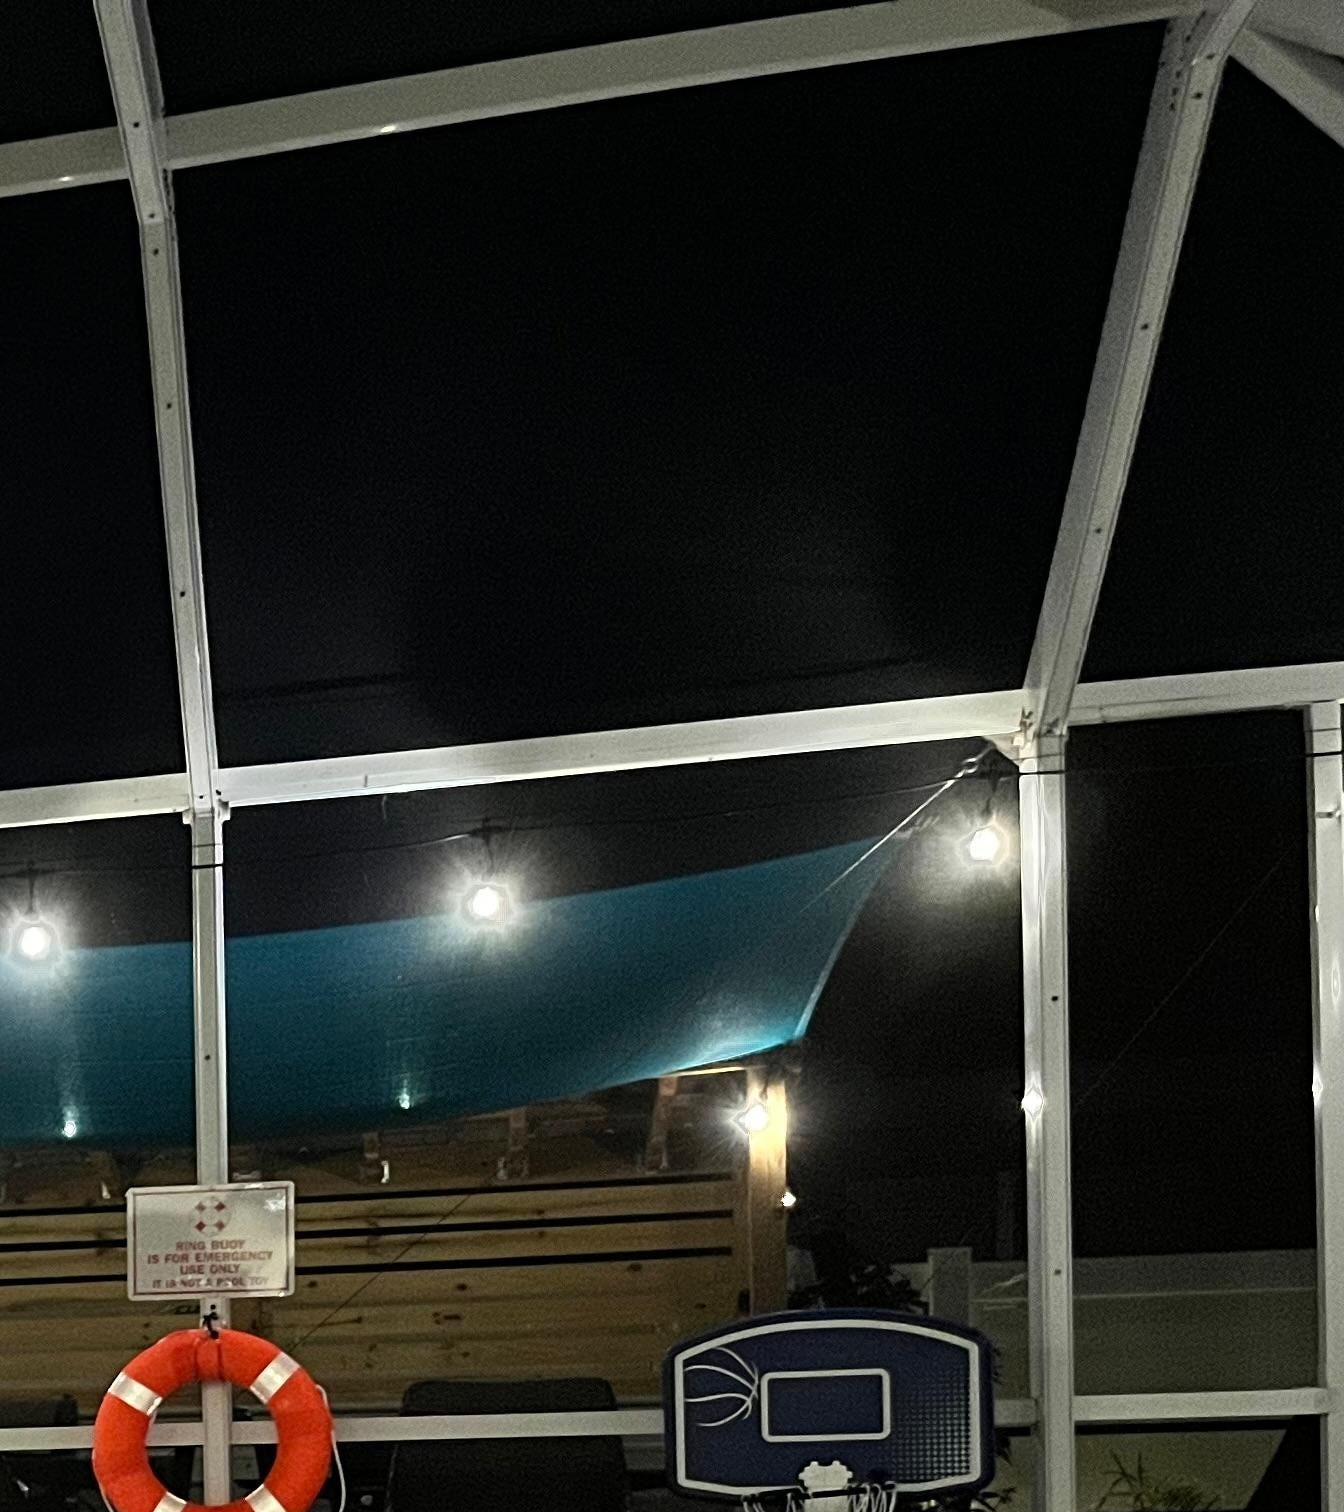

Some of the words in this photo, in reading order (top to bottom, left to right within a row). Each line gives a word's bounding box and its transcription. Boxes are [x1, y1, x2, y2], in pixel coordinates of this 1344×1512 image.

[175, 1241, 206, 1251] RING
[210, 1239, 246, 1250] BUOY
[147, 1254, 160, 1264] IS
[164, 1253, 189, 1264] FOR
[194, 1250, 274, 1263] EMERGENCY
[179, 1265, 205, 1275] USE
[209, 1263, 241, 1274] ONLY
